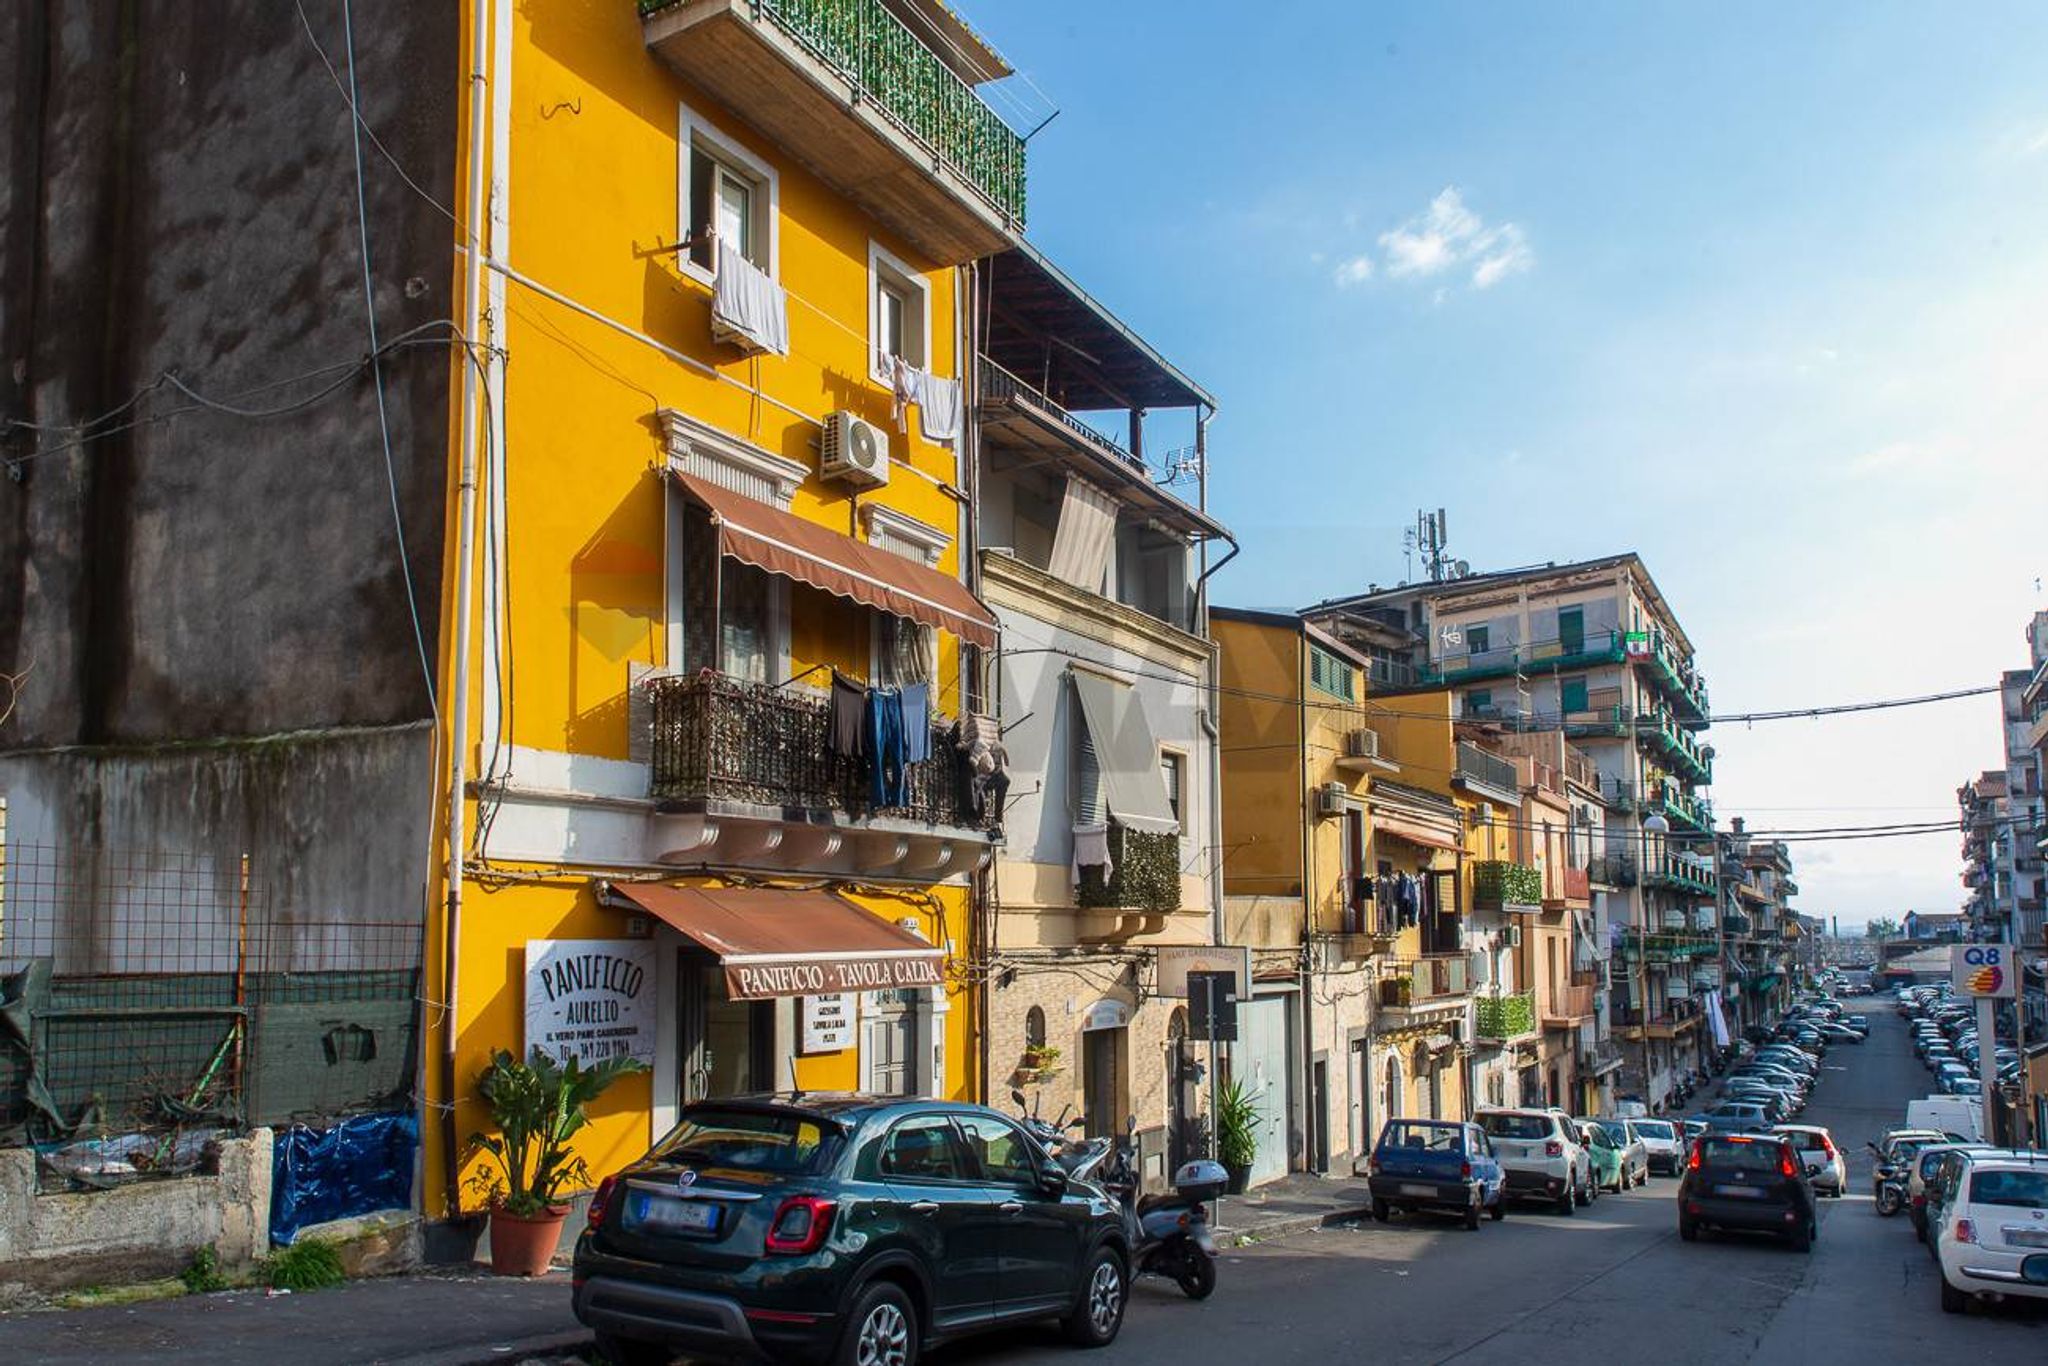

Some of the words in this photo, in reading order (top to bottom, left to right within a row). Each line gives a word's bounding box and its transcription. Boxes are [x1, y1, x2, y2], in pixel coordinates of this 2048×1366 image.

[1965, 948, 2000, 965] Q8
[541, 955, 643, 1002] PANIFICIO
[739, 966, 824, 995] PANIFICIO
[836, 962, 892, 987] TAVOLA
[895, 959, 940, 983] CALDA
[566, 999, 618, 1025] AURELIO
[555, 1031, 575, 1041] VERO
[577, 1029, 595, 1040] PANE
